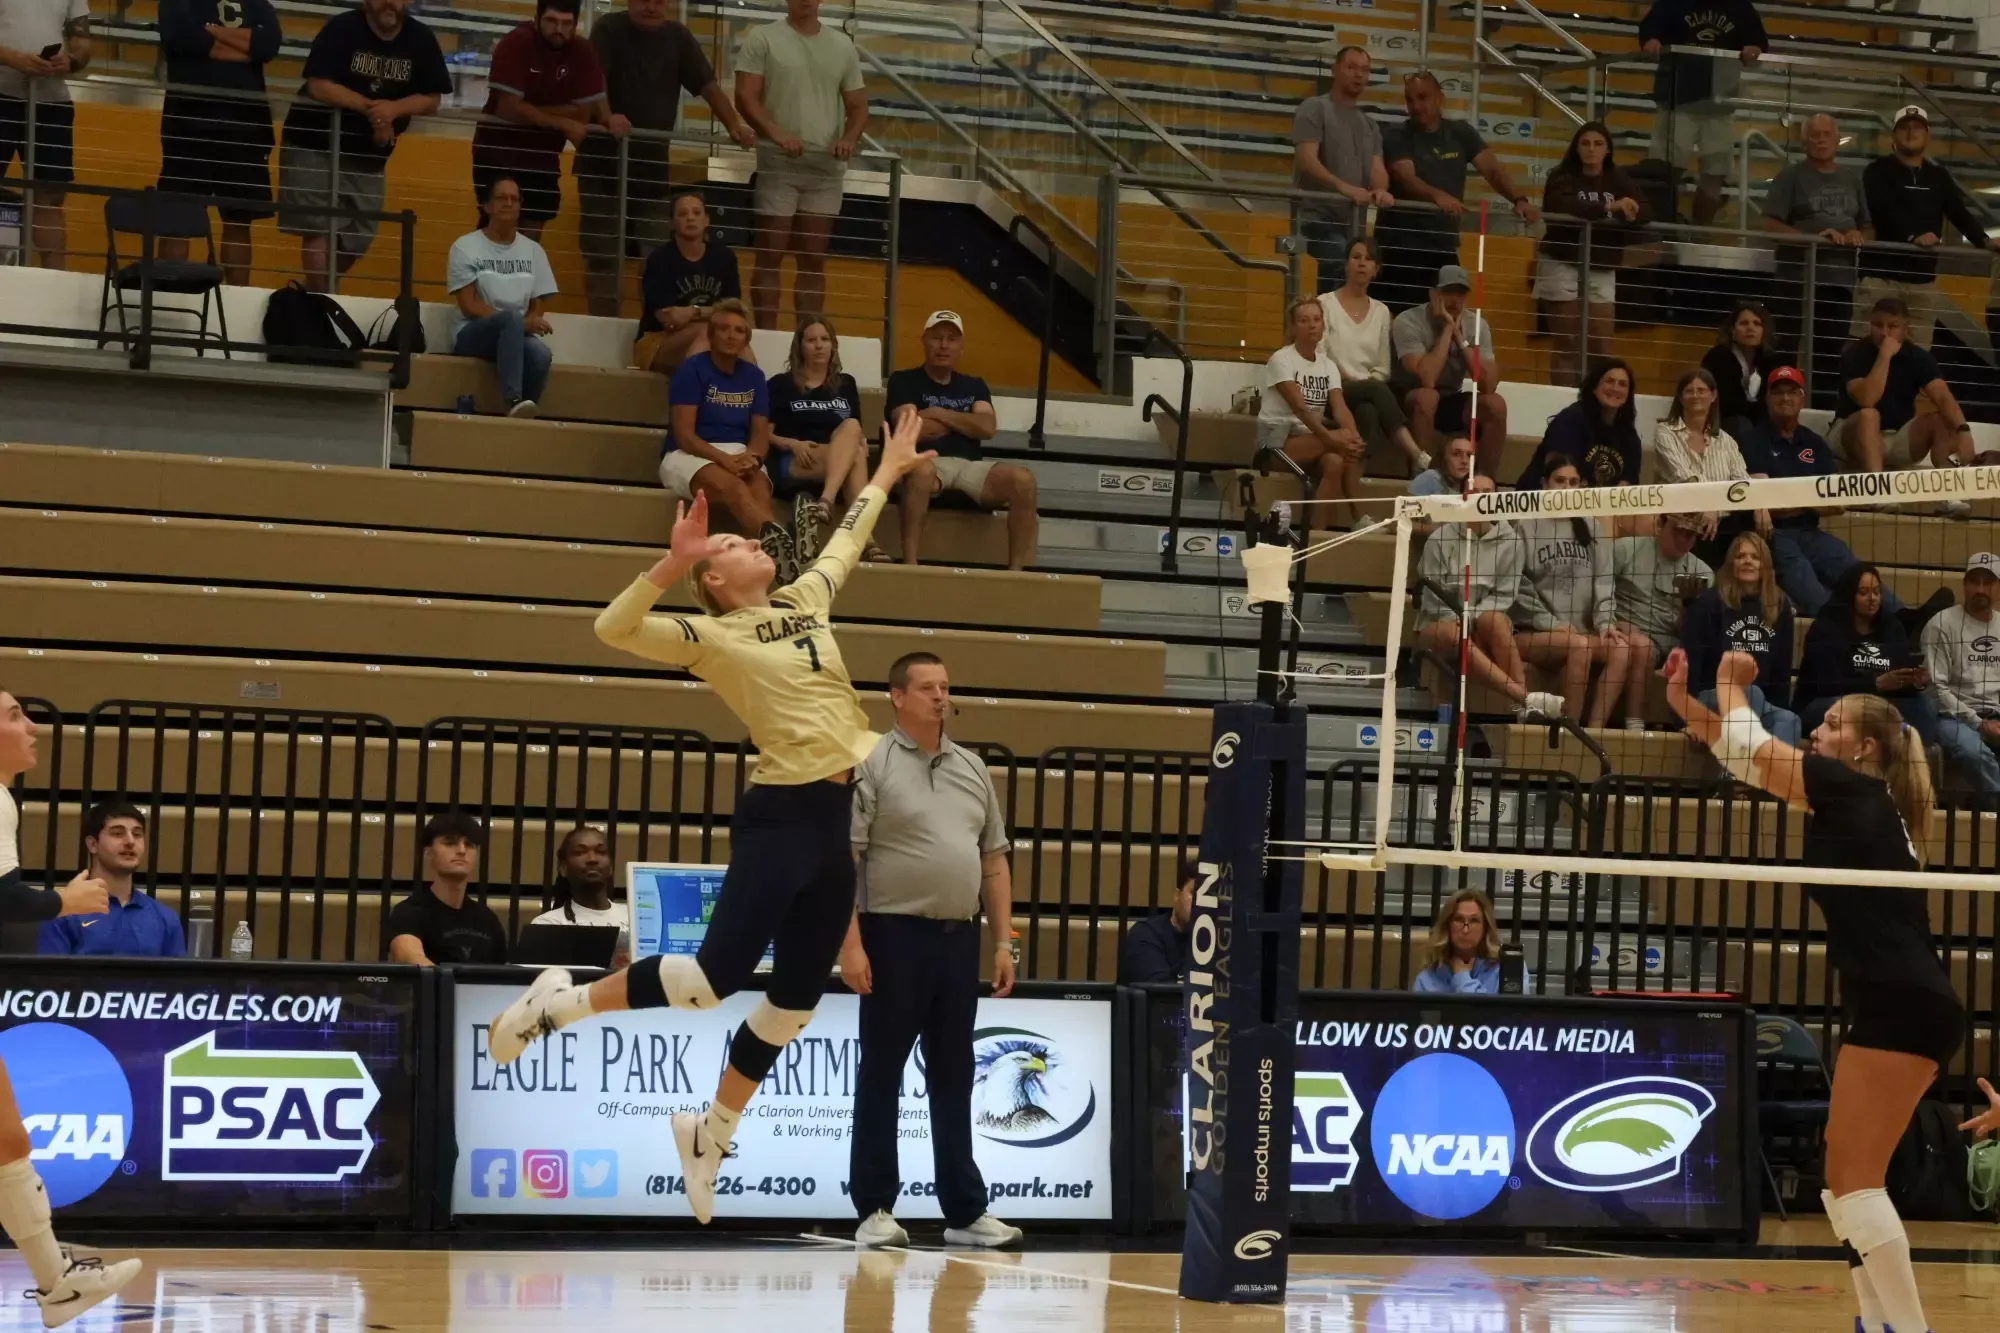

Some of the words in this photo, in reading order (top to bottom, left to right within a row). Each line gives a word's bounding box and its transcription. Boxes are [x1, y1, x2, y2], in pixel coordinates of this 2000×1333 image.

[793, 398, 848, 410] CLARION
[1476, 491, 1540, 515] CLARION
[1542, 488, 1602, 512] GOLDEN
[1609, 485, 1664, 508] EAGLES
[1815, 473, 1891, 498] CLARION
[1895, 470, 1966, 494] GOLDEN
[1980, 554, 1990, 564] B
[792, 636, 821, 672] 7
[1852, 653, 1890, 667] CLARION
[1213, 860, 1233, 999] EAGLES
[1190, 861, 1219, 1171] CLARION
[1295, 1020, 1370, 1048] LLOW
[1374, 1022, 1408, 1048] US
[1413, 1023, 1454, 1050] ON
[1457, 1025, 1549, 1052] SOCIAL
[1555, 1028, 1636, 1054] MEDIA
[600, 1026, 694, 1094] PARK
[1211, 1020, 1231, 1176] GOLDEN
[1257, 1058, 1273, 1122] sports
[169, 1085, 364, 1140] PSAC
[598, 1102, 674, 1117] Off-Campus
[758, 1104, 803, 1118] Clarion
[808, 1105, 855, 1119] Univers
[1291, 1105, 1349, 1155] AC
[22, 1114, 125, 1160] CAA
[773, 1124, 782, 1136] &
[787, 1124, 842, 1140] Working
[1254, 1124, 1271, 1202] imports
[1387, 1133, 1511, 1177] NCAA
[645, 1174, 686, 1196] (814
[713, 1175, 816, 1196] 26-4300
